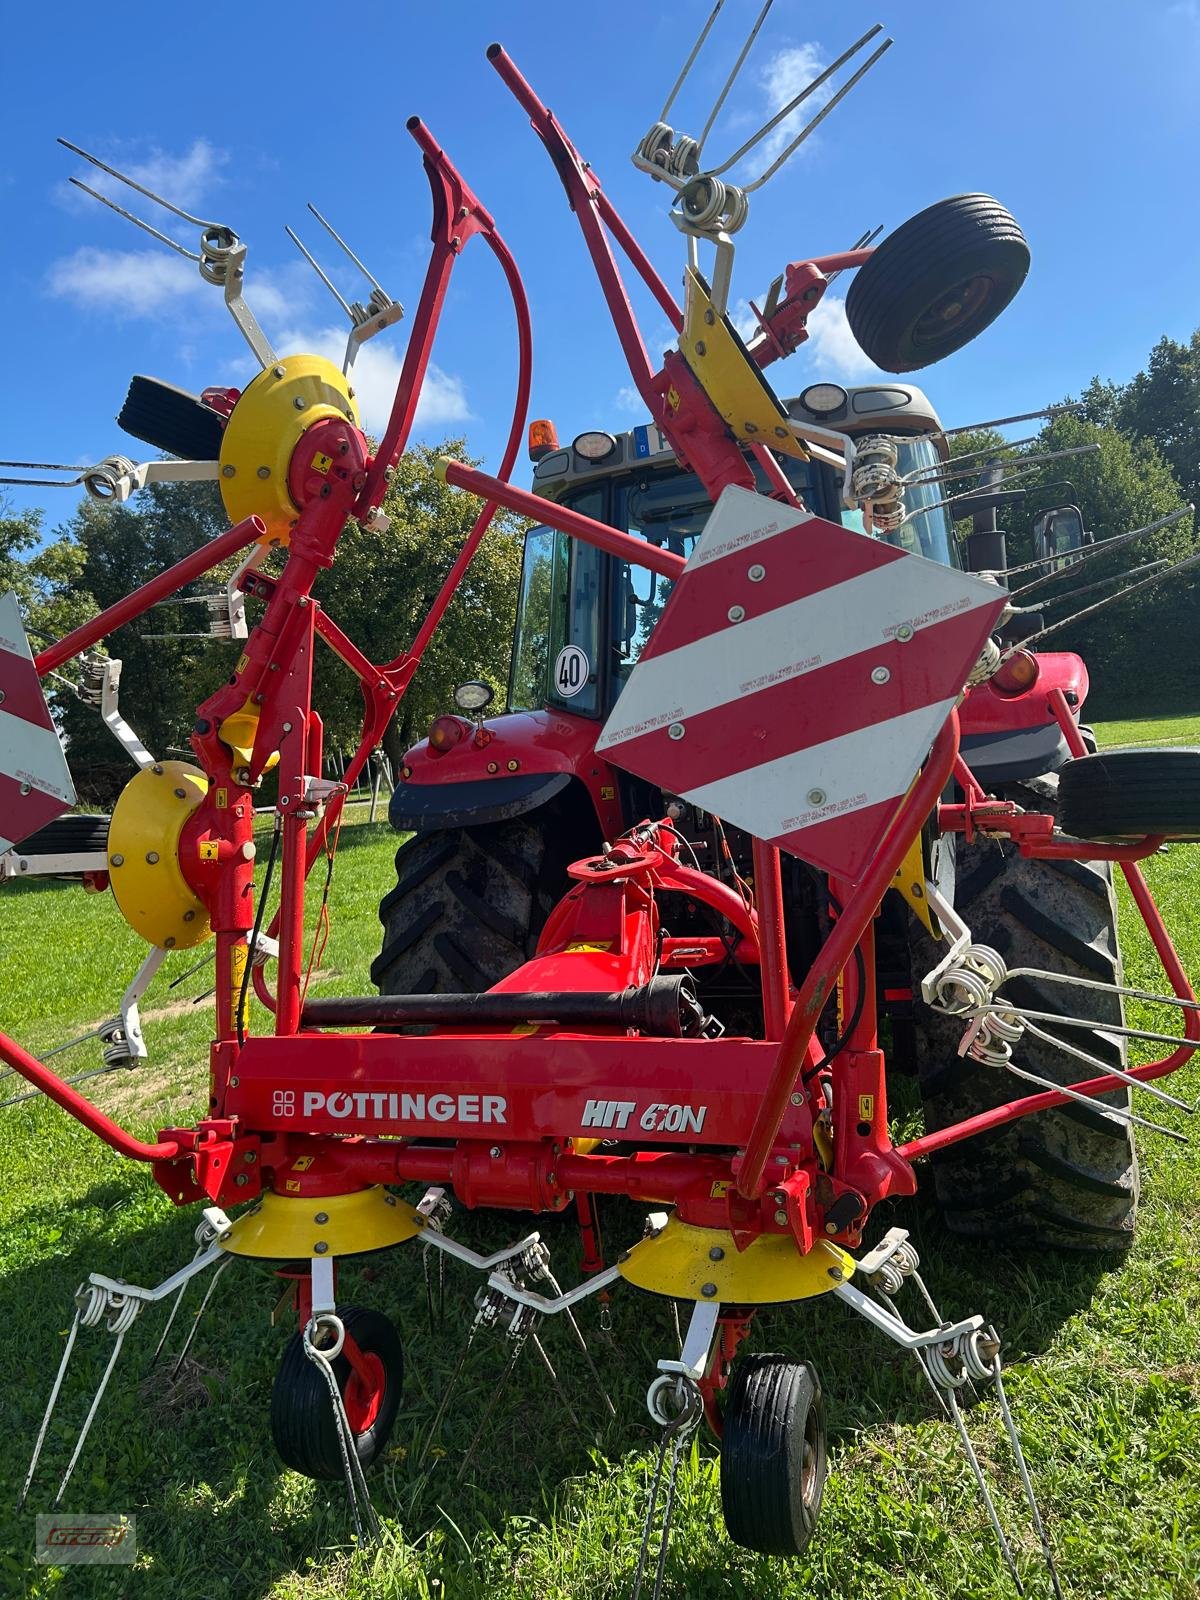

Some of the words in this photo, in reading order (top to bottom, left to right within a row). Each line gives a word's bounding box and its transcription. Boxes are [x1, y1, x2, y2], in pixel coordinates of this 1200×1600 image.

[640, 445, 646, 453] D
[559, 653, 580, 688] 40
[303, 1091, 507, 1123] PÖTTINGER
[581, 1100, 636, 1129] HIT
